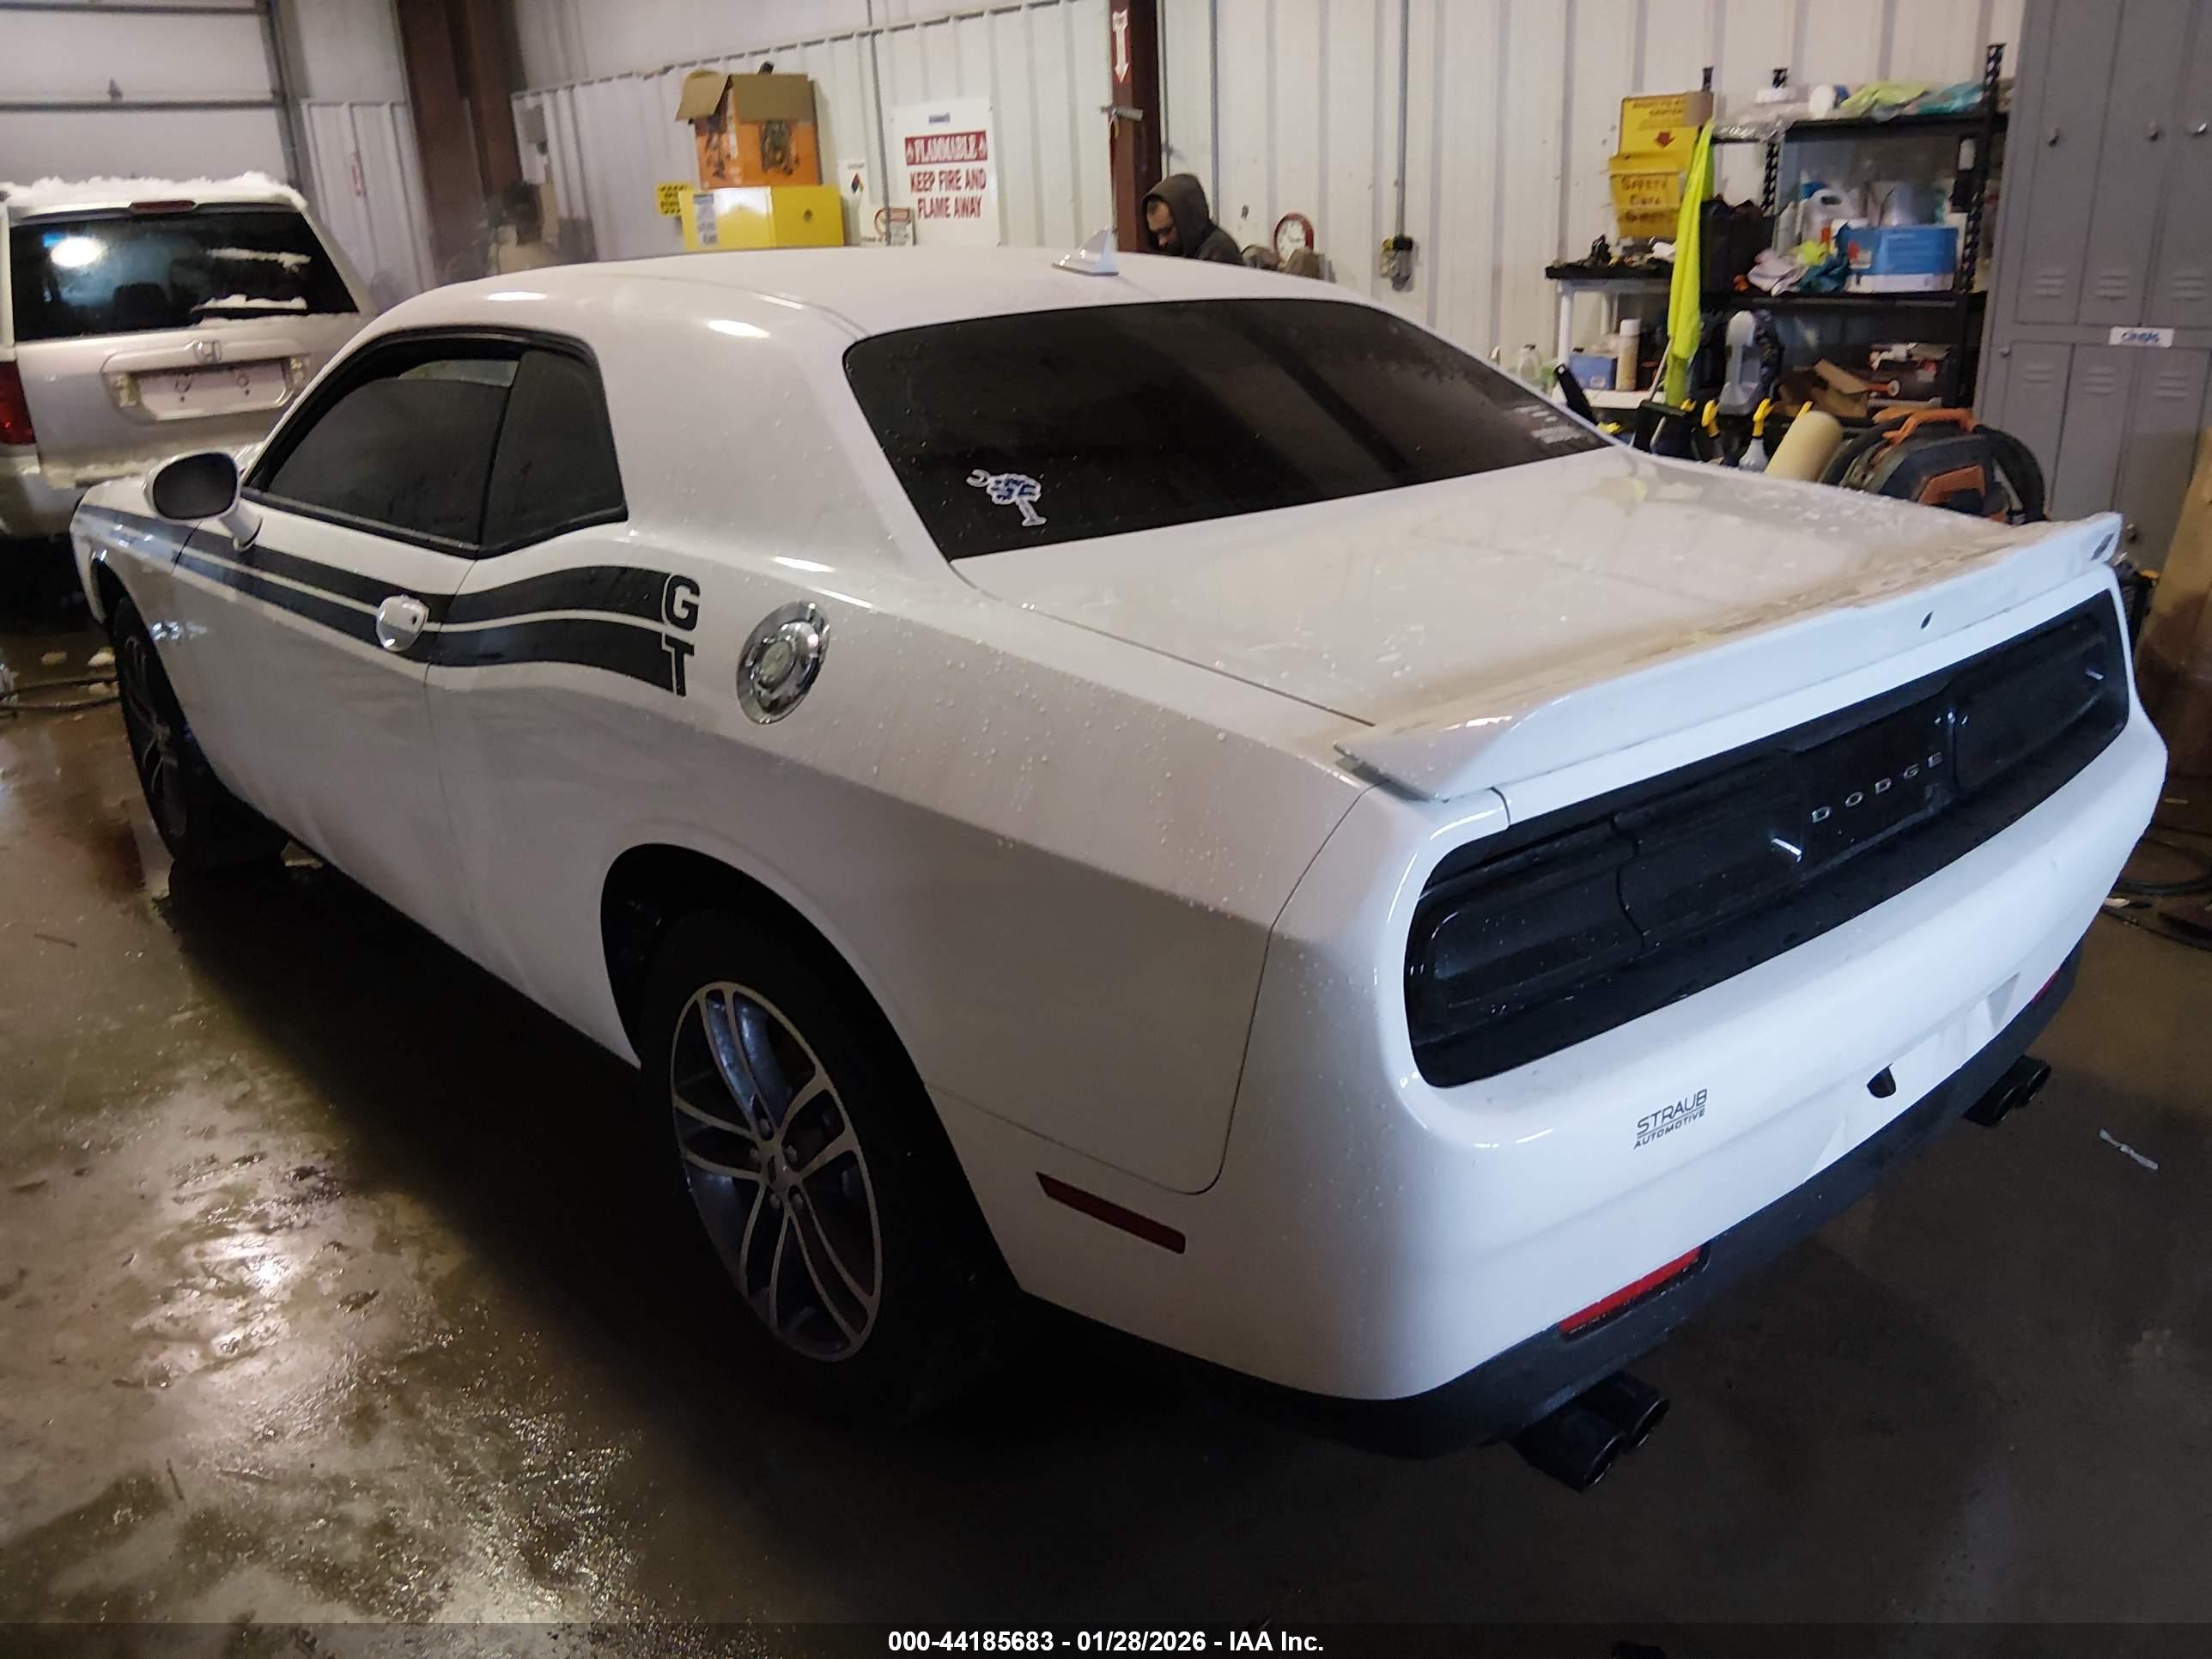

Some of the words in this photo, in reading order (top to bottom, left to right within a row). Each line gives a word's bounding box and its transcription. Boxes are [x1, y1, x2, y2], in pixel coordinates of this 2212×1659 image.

[914, 134, 978, 163] FLAMMABLE
[909, 170, 935, 194] KEEP
[939, 168, 962, 191] FIRE
[965, 167, 987, 190] AND
[917, 197, 951, 220] FLAME
[954, 194, 982, 219] AWAY
[1811, 751, 1943, 823] DODGE
[1633, 1106, 1706, 1150] AUTOMOTIVE
[1636, 1088, 1708, 1136] STRAUB
